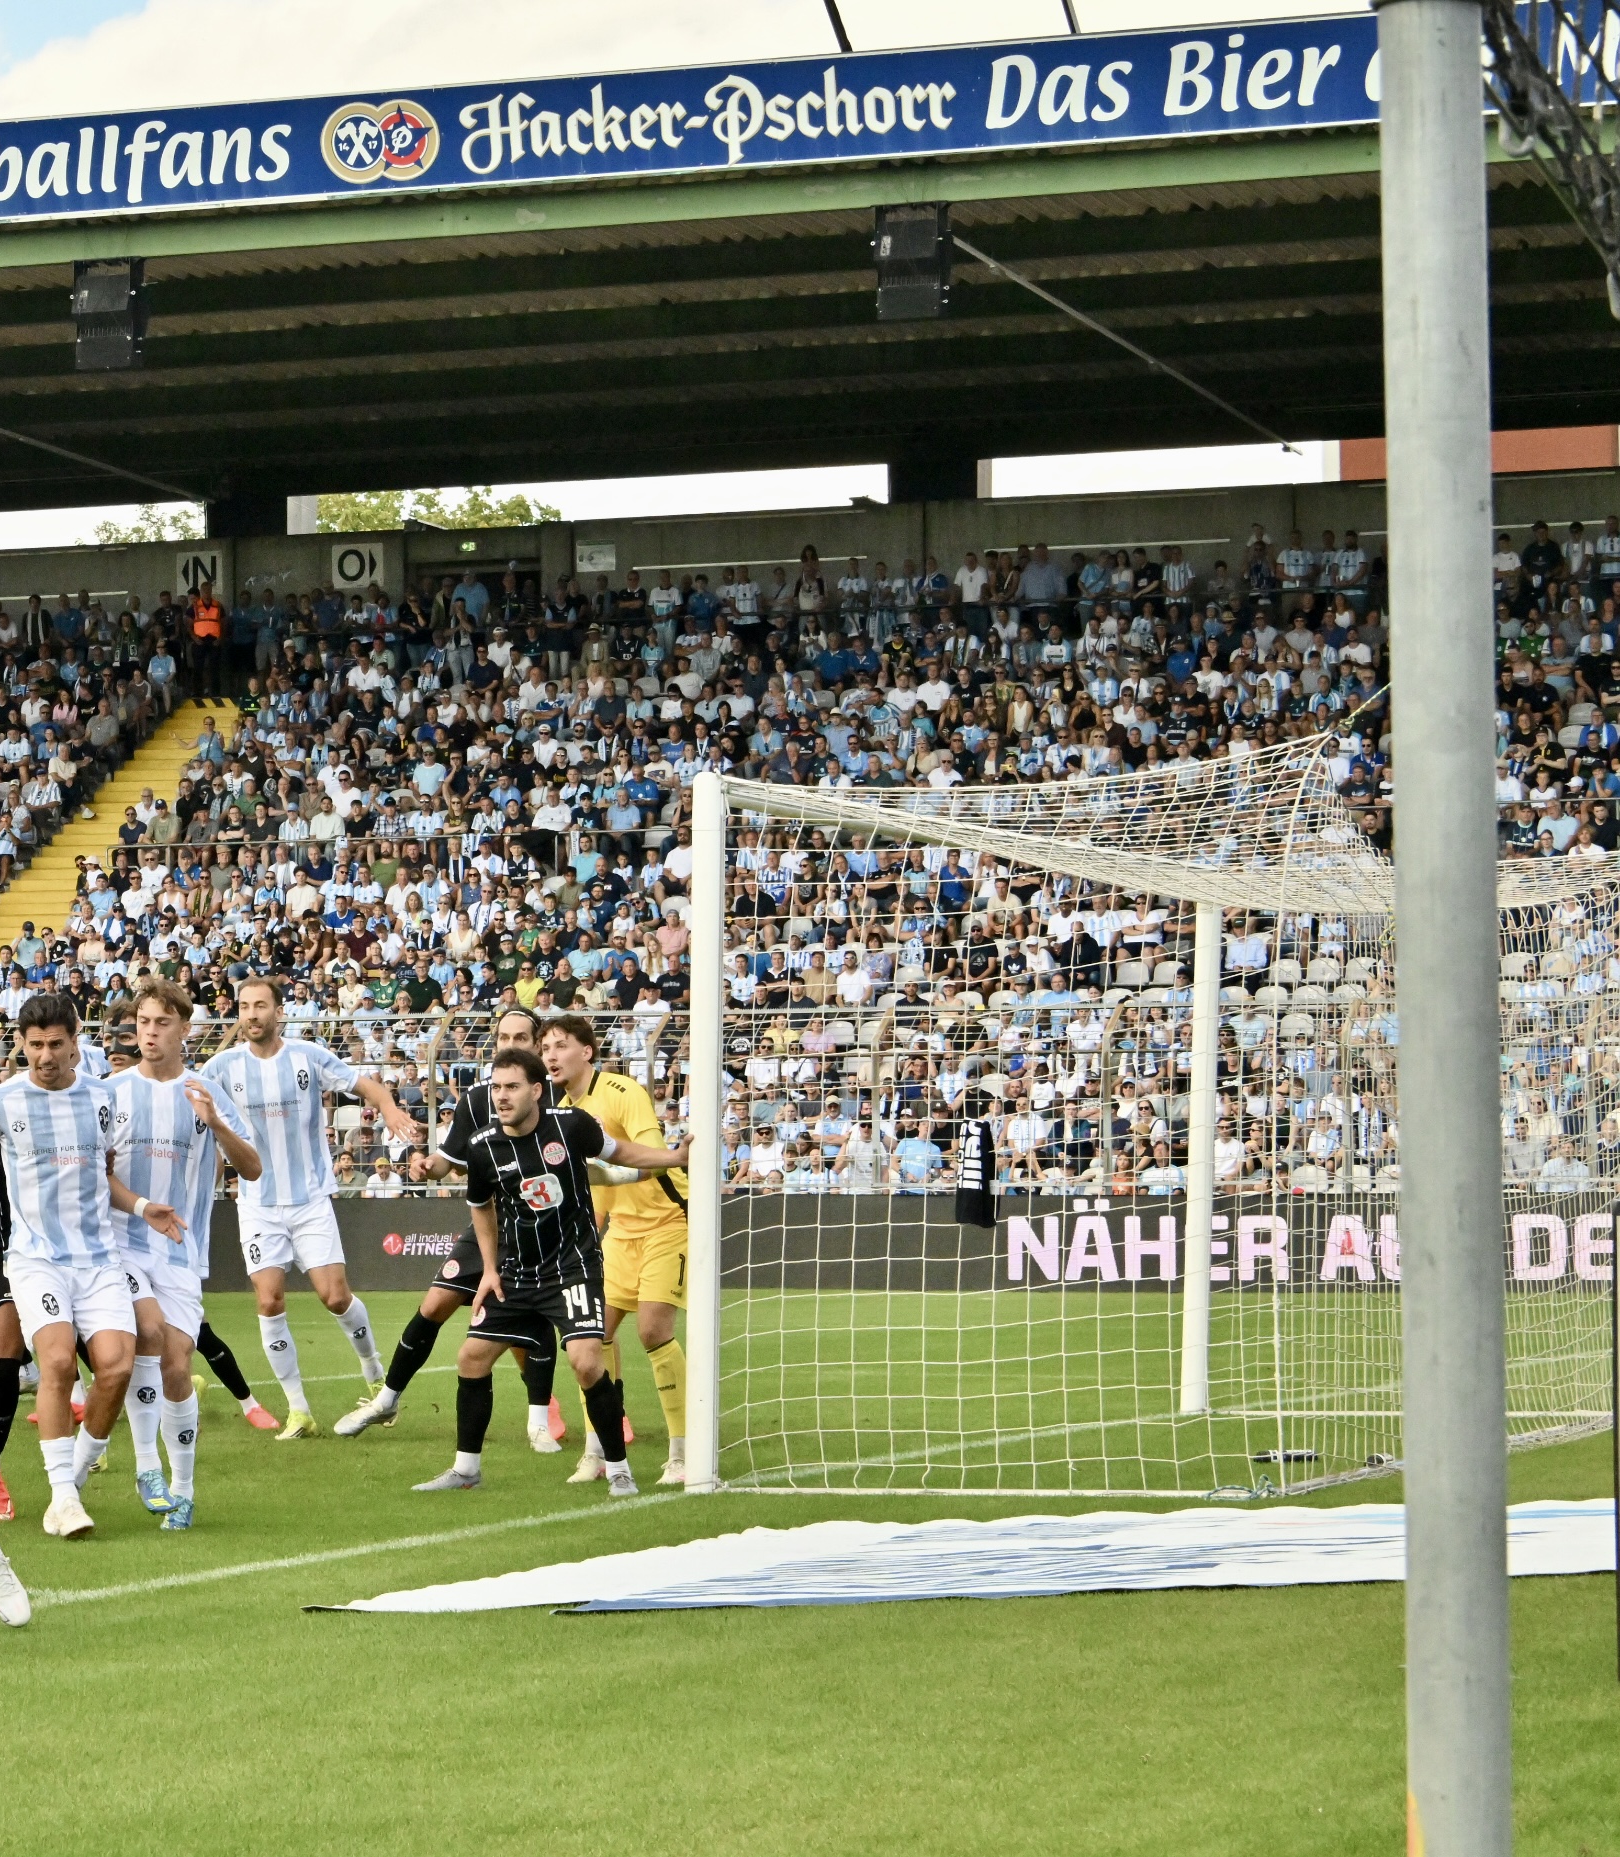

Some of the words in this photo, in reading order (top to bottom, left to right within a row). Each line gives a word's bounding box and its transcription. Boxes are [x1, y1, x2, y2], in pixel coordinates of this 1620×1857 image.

[985, 54, 1132, 130] Das
[1163, 34, 1341, 117] Bier
[458, 65, 957, 174] Hacker-Pschorr
[338, 143, 350, 151] 14
[368, 140, 378, 149] 17
[193, 556, 216, 588] N
[338, 549, 366, 581] O
[156, 1137, 171, 1146] FÜR
[405, 1233, 417, 1243] all
[561, 1284, 589, 1320] 14
